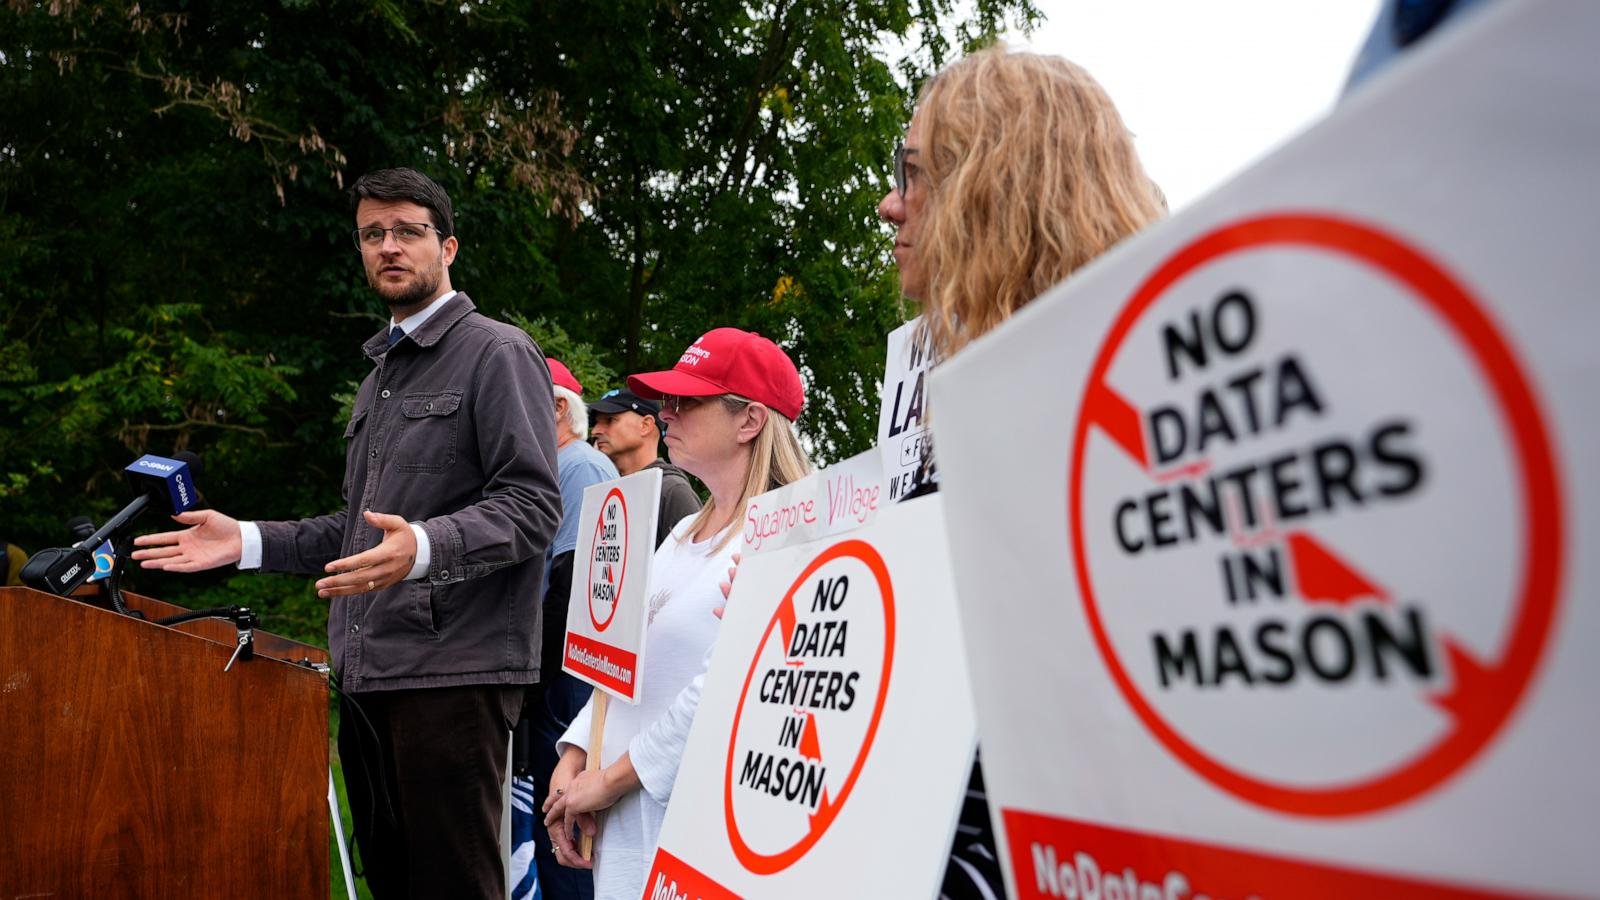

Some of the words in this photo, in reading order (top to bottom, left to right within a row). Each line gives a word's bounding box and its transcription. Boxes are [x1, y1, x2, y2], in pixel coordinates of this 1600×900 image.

[1161, 289, 1258, 381] NO
[888, 370, 929, 438] LA
[1147, 354, 1324, 465] DATA
[139, 460, 174, 472] C-SPAN
[175, 473, 190, 506] C-SPAN
[1114, 421, 1425, 555] CENTERS
[606, 504, 616, 520] NO
[744, 500, 817, 550] Sycamore
[827, 474, 880, 526] Village
[602, 524, 617, 541] DATA
[595, 546, 620, 562] CENTERS
[602, 566, 608, 580] IN
[592, 582, 615, 602] MASON
[811, 575, 849, 613] NO
[1222, 548, 1285, 605] IN
[788, 620, 848, 658] DATA
[1152, 605, 1435, 689] MASON
[568, 642, 631, 684] NoDataCentersInMason.com
[759, 669, 860, 712] CENTERS
[778, 715, 804, 749] IN
[739, 750, 826, 808] MASON
